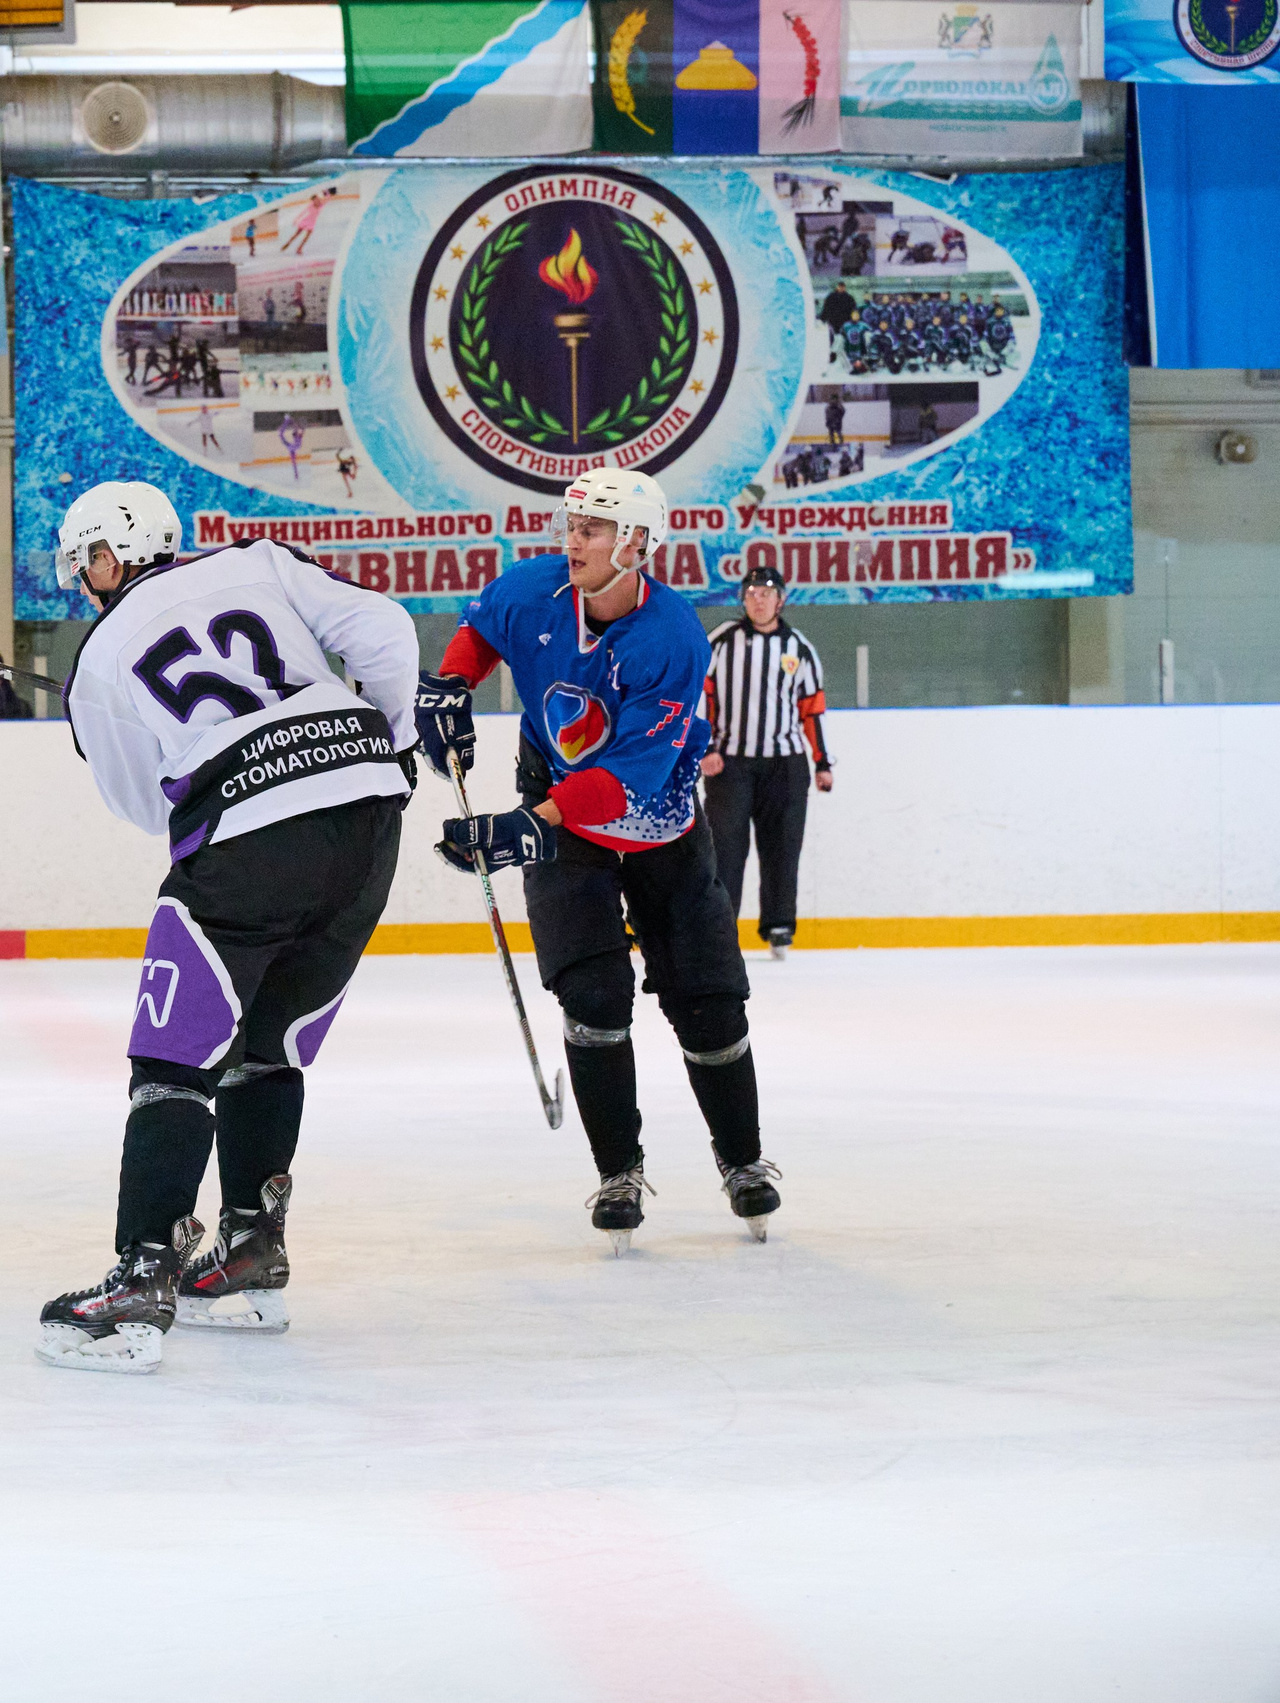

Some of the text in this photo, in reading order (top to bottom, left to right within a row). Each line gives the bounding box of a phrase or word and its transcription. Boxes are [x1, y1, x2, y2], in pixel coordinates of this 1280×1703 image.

[503, 178, 637, 213] ОЛИМПИЯ
[461, 406, 692, 477] СПОРТИВНАЯ ШКОЛА
[78, 525, 101, 537] CCM
[198, 512, 492, 546] Муниципального
[723, 537, 1032, 584] «ОЛИМПИЯ»
[132, 609, 315, 724] 52
[241, 716, 363, 763] ЦИФРОВАЯ
[221, 737, 394, 799] СТОМАТОЛОГИЯ
